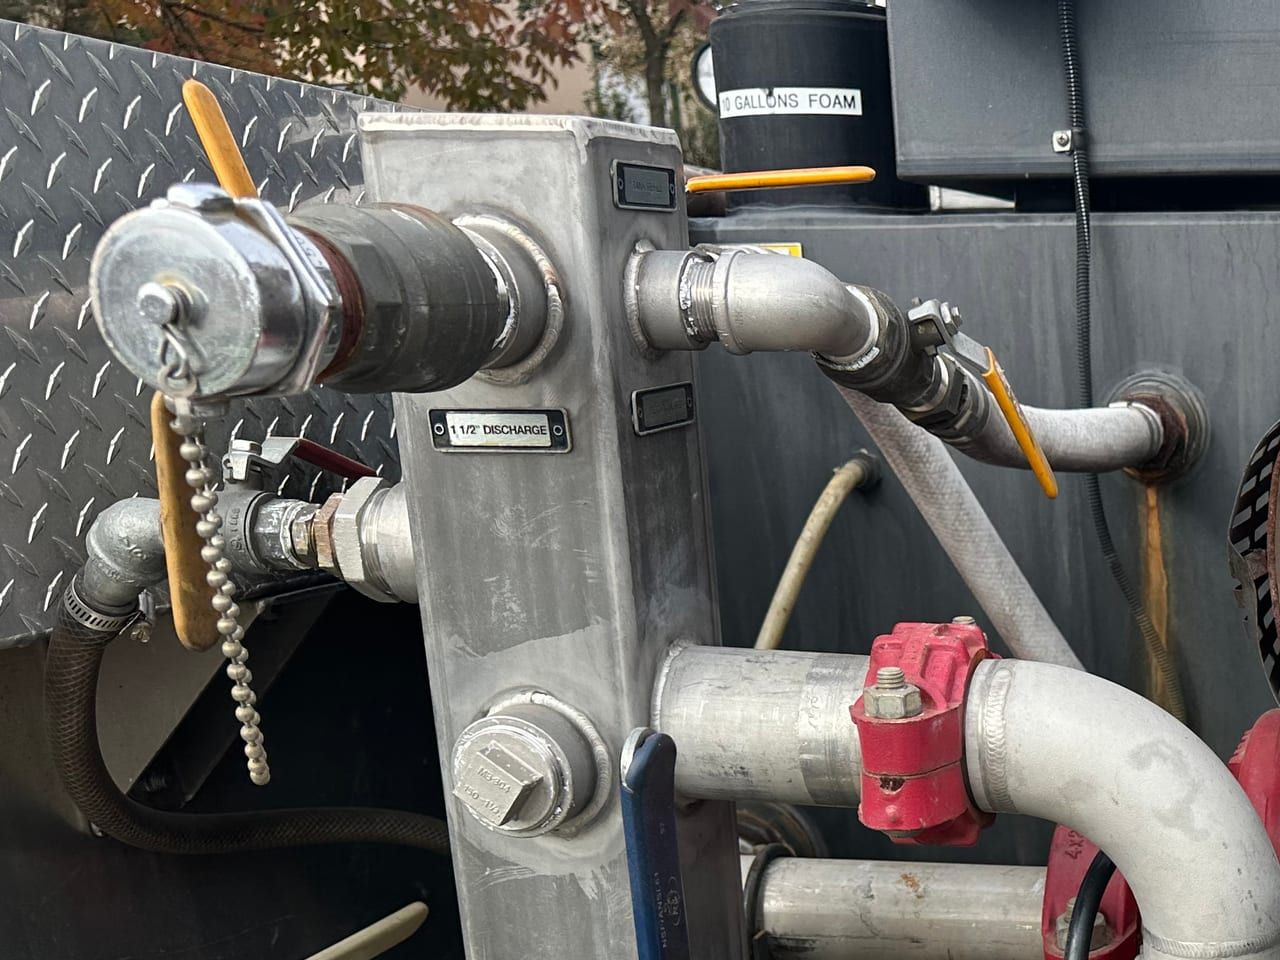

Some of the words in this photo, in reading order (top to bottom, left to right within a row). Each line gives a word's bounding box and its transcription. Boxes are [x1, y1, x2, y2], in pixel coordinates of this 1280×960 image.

[734, 94, 799, 110] GALLONS
[808, 93, 857, 109] FOAM
[450, 425, 457, 435] 1
[483, 425, 548, 436] DISCHARGE
